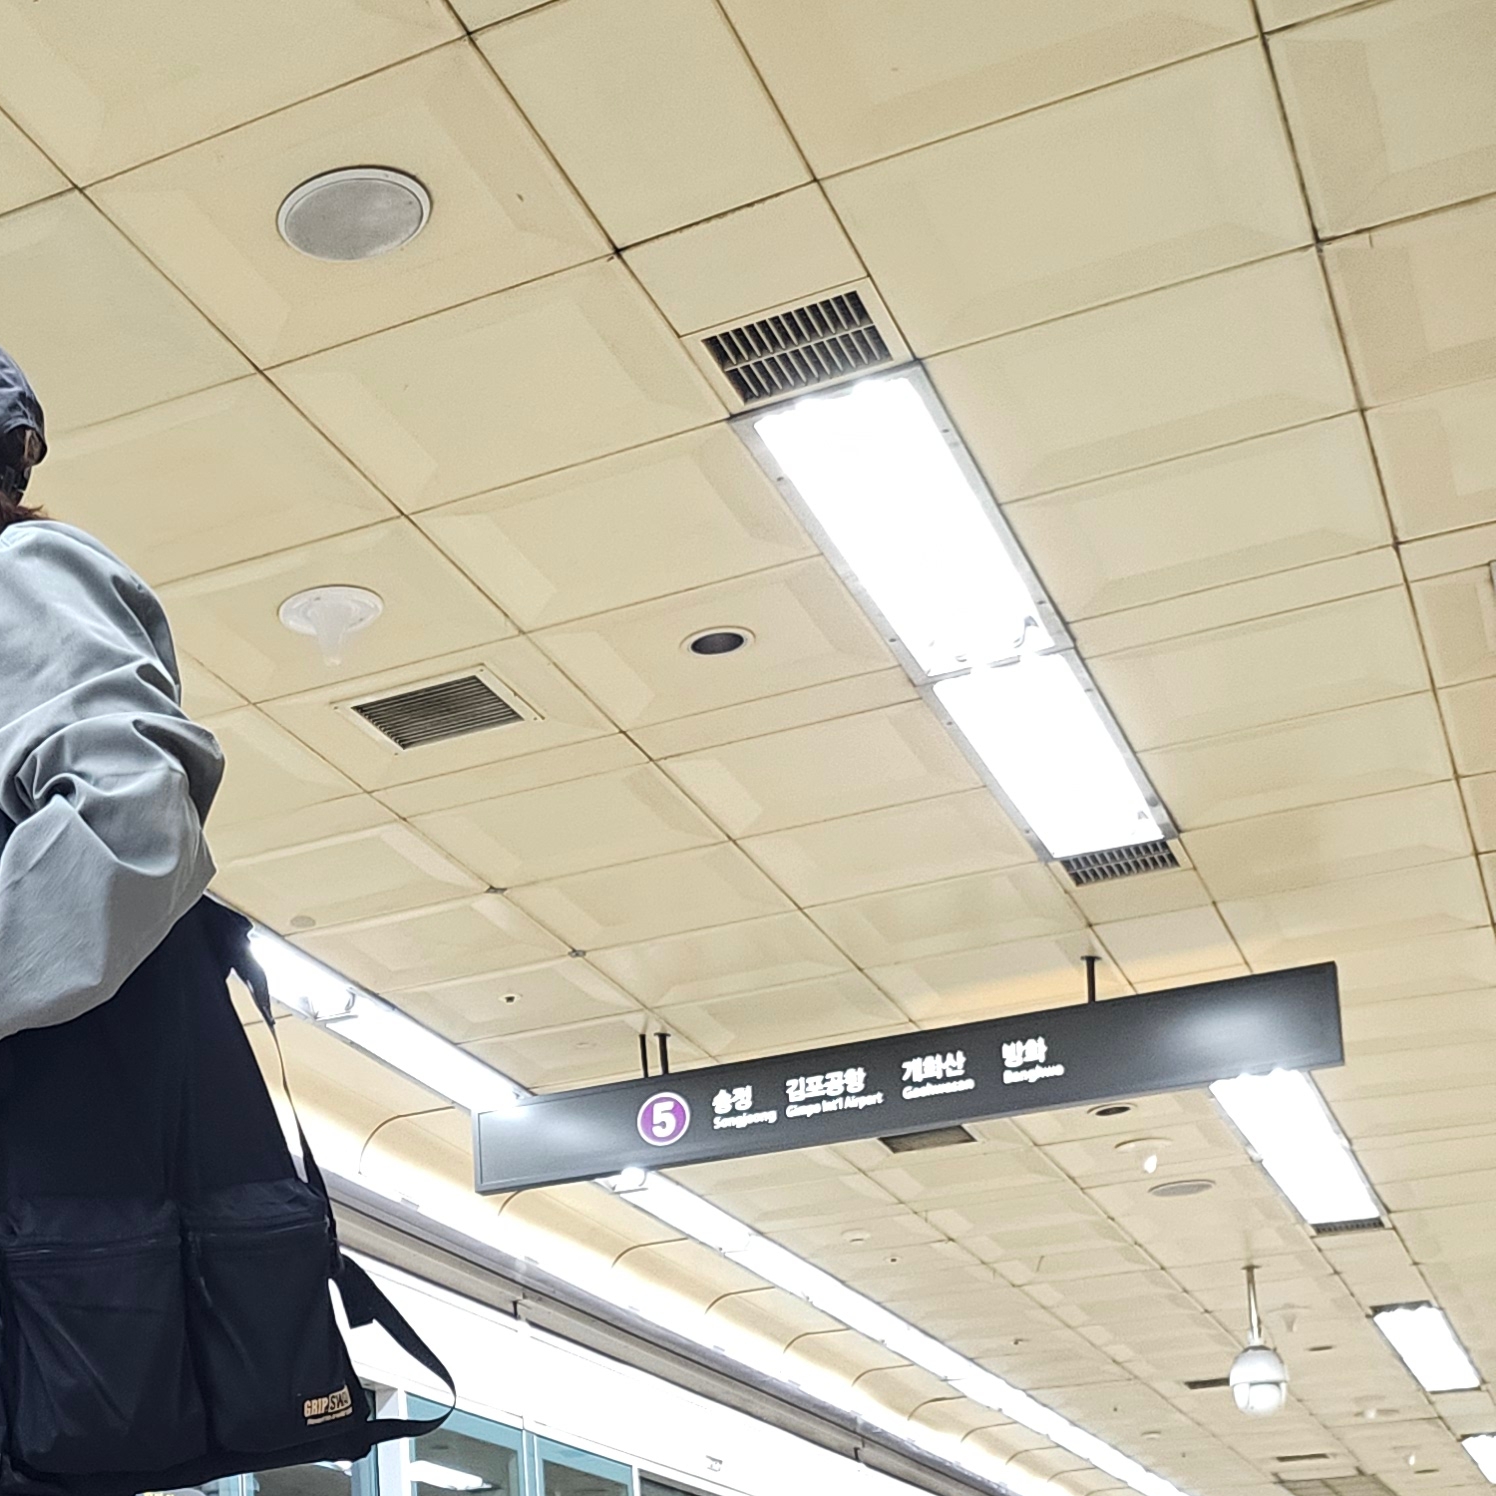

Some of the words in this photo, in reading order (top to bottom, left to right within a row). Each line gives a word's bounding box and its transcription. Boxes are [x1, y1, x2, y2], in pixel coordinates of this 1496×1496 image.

[712, 1085, 753, 1115] 송정
[785, 1067, 866, 1102] 김포공항
[901, 1050, 967, 1082] 개화산
[1002, 1036, 1048, 1068] 방화
[651, 1101, 675, 1138] 5
